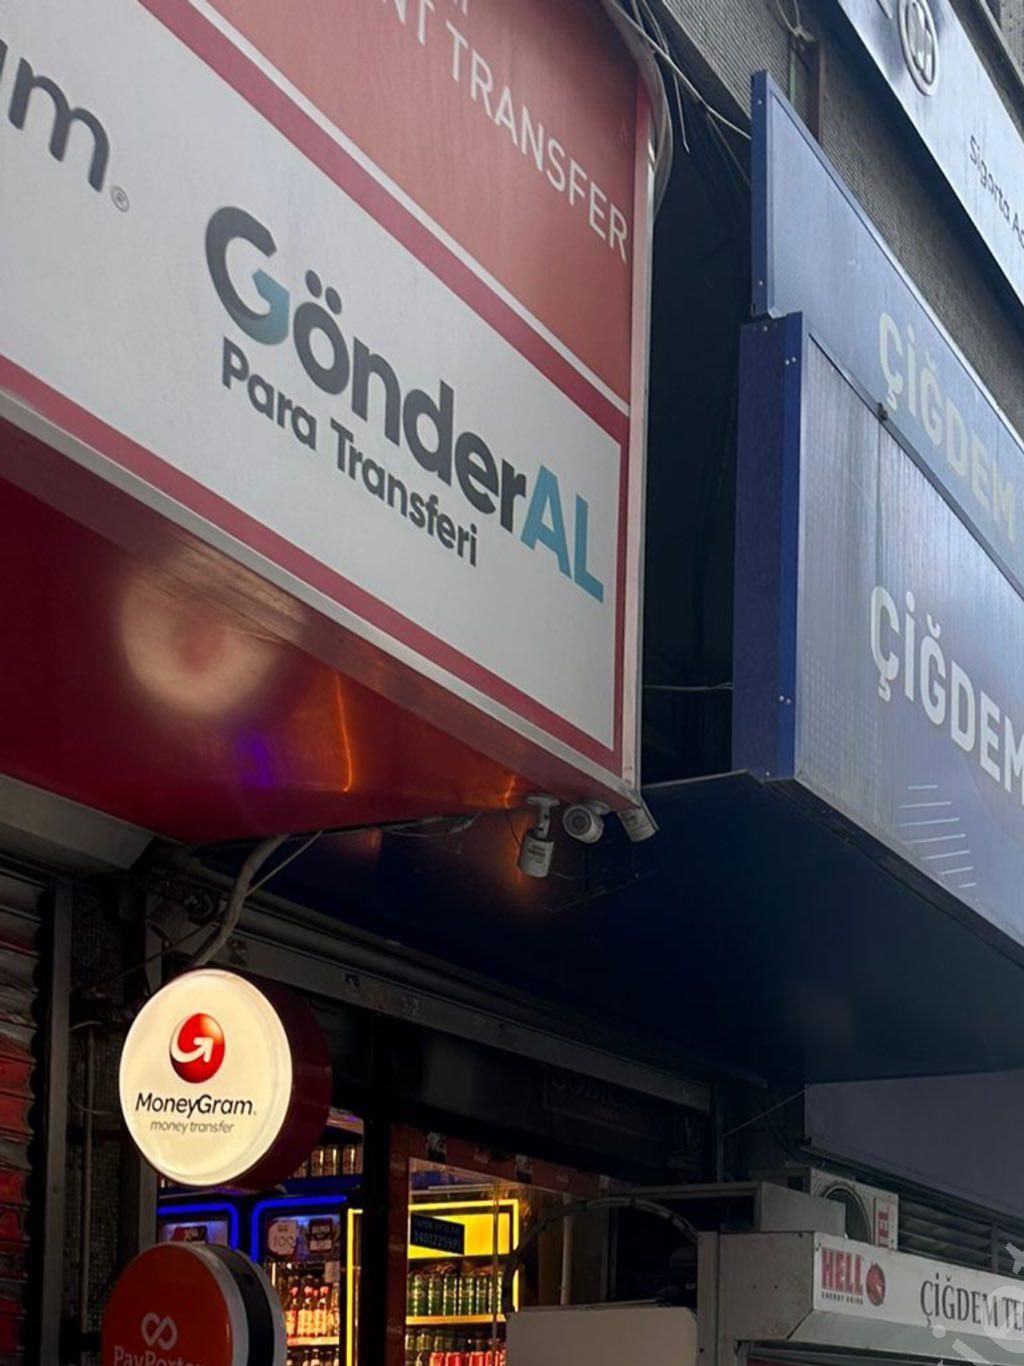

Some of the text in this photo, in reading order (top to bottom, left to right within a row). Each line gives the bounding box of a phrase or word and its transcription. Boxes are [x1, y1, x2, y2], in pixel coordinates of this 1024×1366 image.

[446, 20, 627, 264] TRANSFER
[205, 206, 604, 604] GönderAL
[221, 336, 478, 567] Para Transferi
[880, 312, 1014, 544] ÇİĞDEM
[135, 1092, 253, 1118] MoneyGram
[150, 1120, 235, 1135] money transfer
[822, 1247, 864, 1296] HELL
[920, 1271, 998, 1328] ÇİĞDEM
